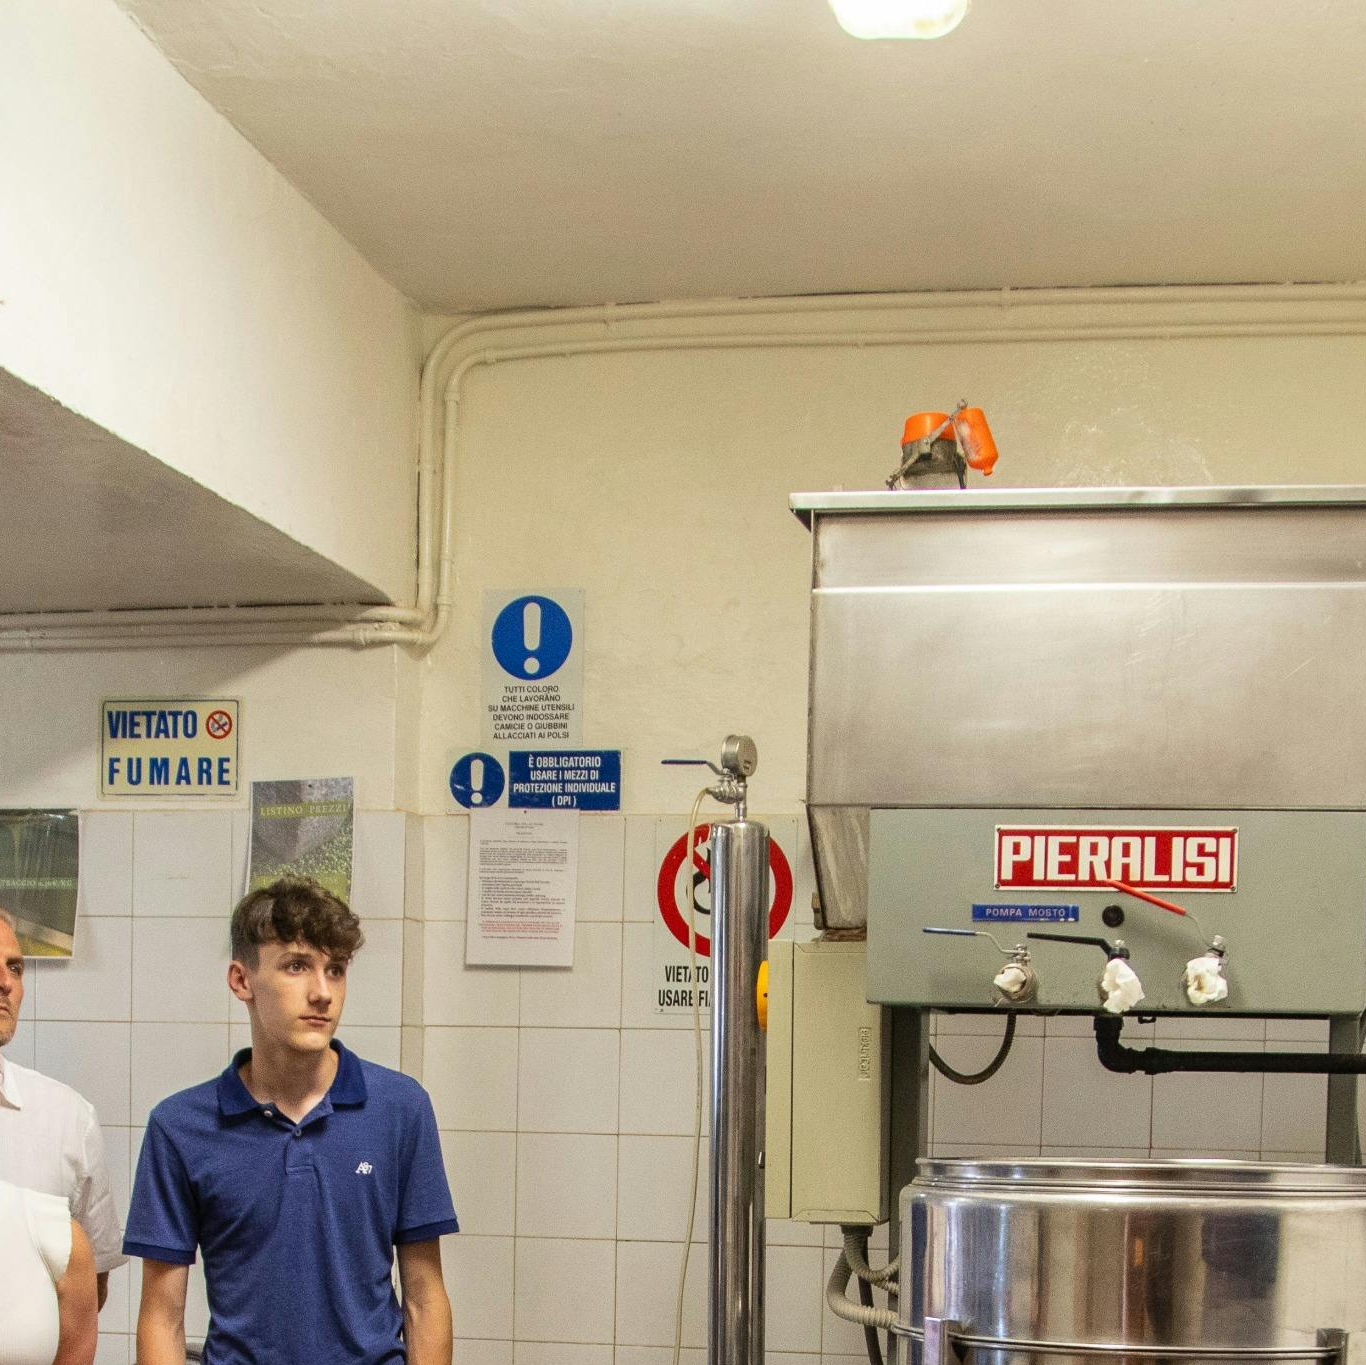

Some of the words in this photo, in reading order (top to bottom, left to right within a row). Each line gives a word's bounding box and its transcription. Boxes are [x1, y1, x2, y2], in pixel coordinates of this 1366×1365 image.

[527, 685, 559, 694] COLORO
[520, 694, 561, 702] LAVORANO
[488, 704, 498, 712] SU
[500, 704, 539, 712] MACCHINE
[526, 712, 569, 720] INDOSSARE
[107, 710, 198, 739] VIETATO
[495, 722, 525, 730] CAMICIE
[535, 722, 568, 730] GIUBBINI
[493, 732, 536, 740] ALLACCIATI
[529, 754, 534, 768] È
[537, 756, 601, 768] OBBLIGATORIO
[108, 757, 231, 786] FUMARE
[531, 770, 557, 780] USARE
[564, 770, 588, 780] MEZZI
[590, 770, 599, 780] DI
[513, 783, 563, 793] PROTEZIONE
[565, 782, 616, 793] INDIVIDUALE
[261, 806, 303, 816] LISTINO
[310, 803, 347, 814] PREZZI
[1000, 835, 1232, 883] PIERALISI
[986, 908, 1022, 916] POMPA
[1029, 908, 1065, 917] MOSTO
[699, 991, 711, 1006] FI
